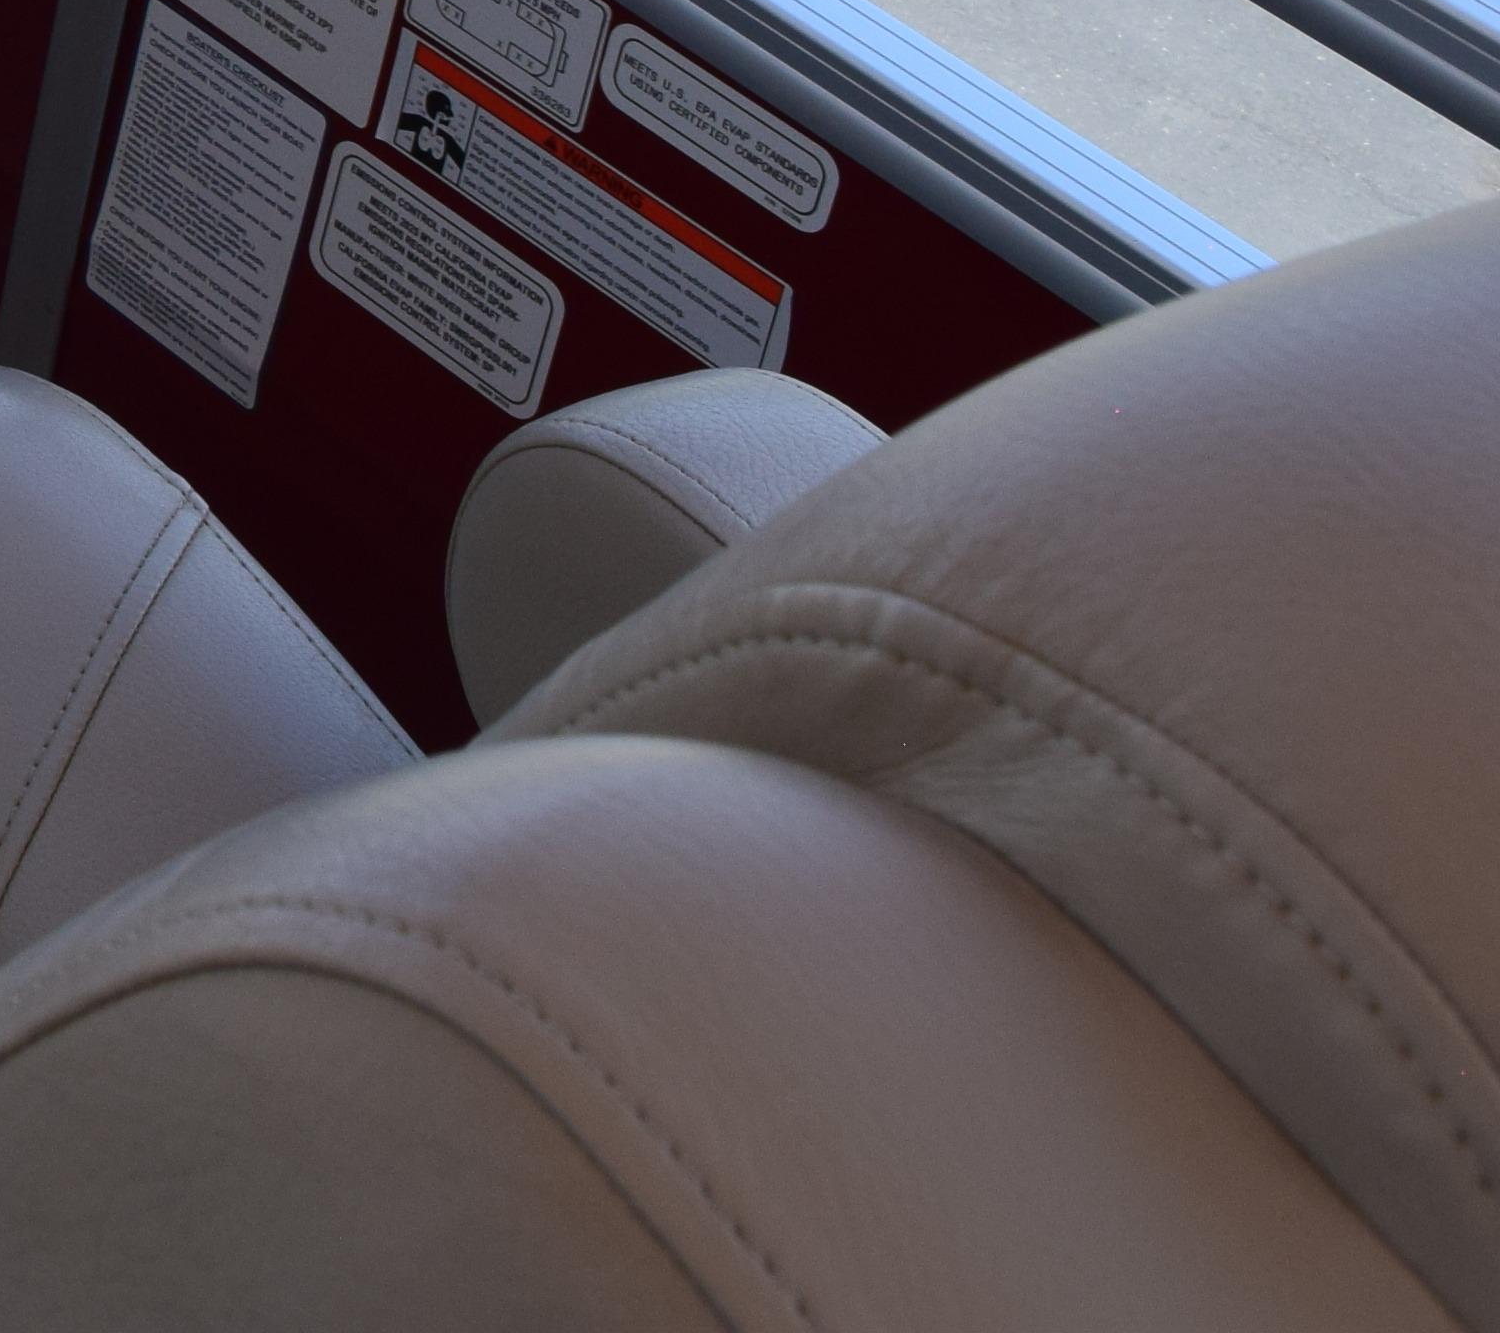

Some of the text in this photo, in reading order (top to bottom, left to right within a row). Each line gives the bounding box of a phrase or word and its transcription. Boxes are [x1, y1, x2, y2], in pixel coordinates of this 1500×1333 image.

[264, 6, 294, 32] MARINE
[297, 28, 326, 54] GROUP
[306, 9, 315, 22] 22
[366, 4, 377, 18] OF
[540, 2, 560, 19] MPH
[187, 32, 284, 105] BOATER'S CHECKLIST
[623, 54, 818, 188] MEETS U.S. EPA EVAP STANDARDS
[629, 75, 803, 195] USING CERTIFIED COMPONENTS
[563, 146, 641, 209] WARNING
[338, 242, 387, 282] CALIFORNIA
[389, 279, 412, 300] EVAP
[351, 165, 543, 305] EMISSIONS CONTROL SYSTEMS INFORMATION
[358, 202, 403, 239] EMISSIONS
[405, 236, 465, 283] REGULATIONS
[468, 280, 485, 297] FOR
[368, 224, 499, 322] IGNITION MARINE WATERCRAFT
[369, 196, 398, 221] MEETS
[435, 242, 486, 283] CALIFORNIA
[488, 280, 512, 302] EVAP
[354, 268, 398, 305] EMISSIONS
[400, 301, 440, 335] CONTROL
[482, 360, 494, 374] SP
[407, 273, 433, 297] WHITE
[436, 293, 461, 317] RIVER
[463, 313, 496, 342] MARINE
[499, 338, 530, 366] GROUP
